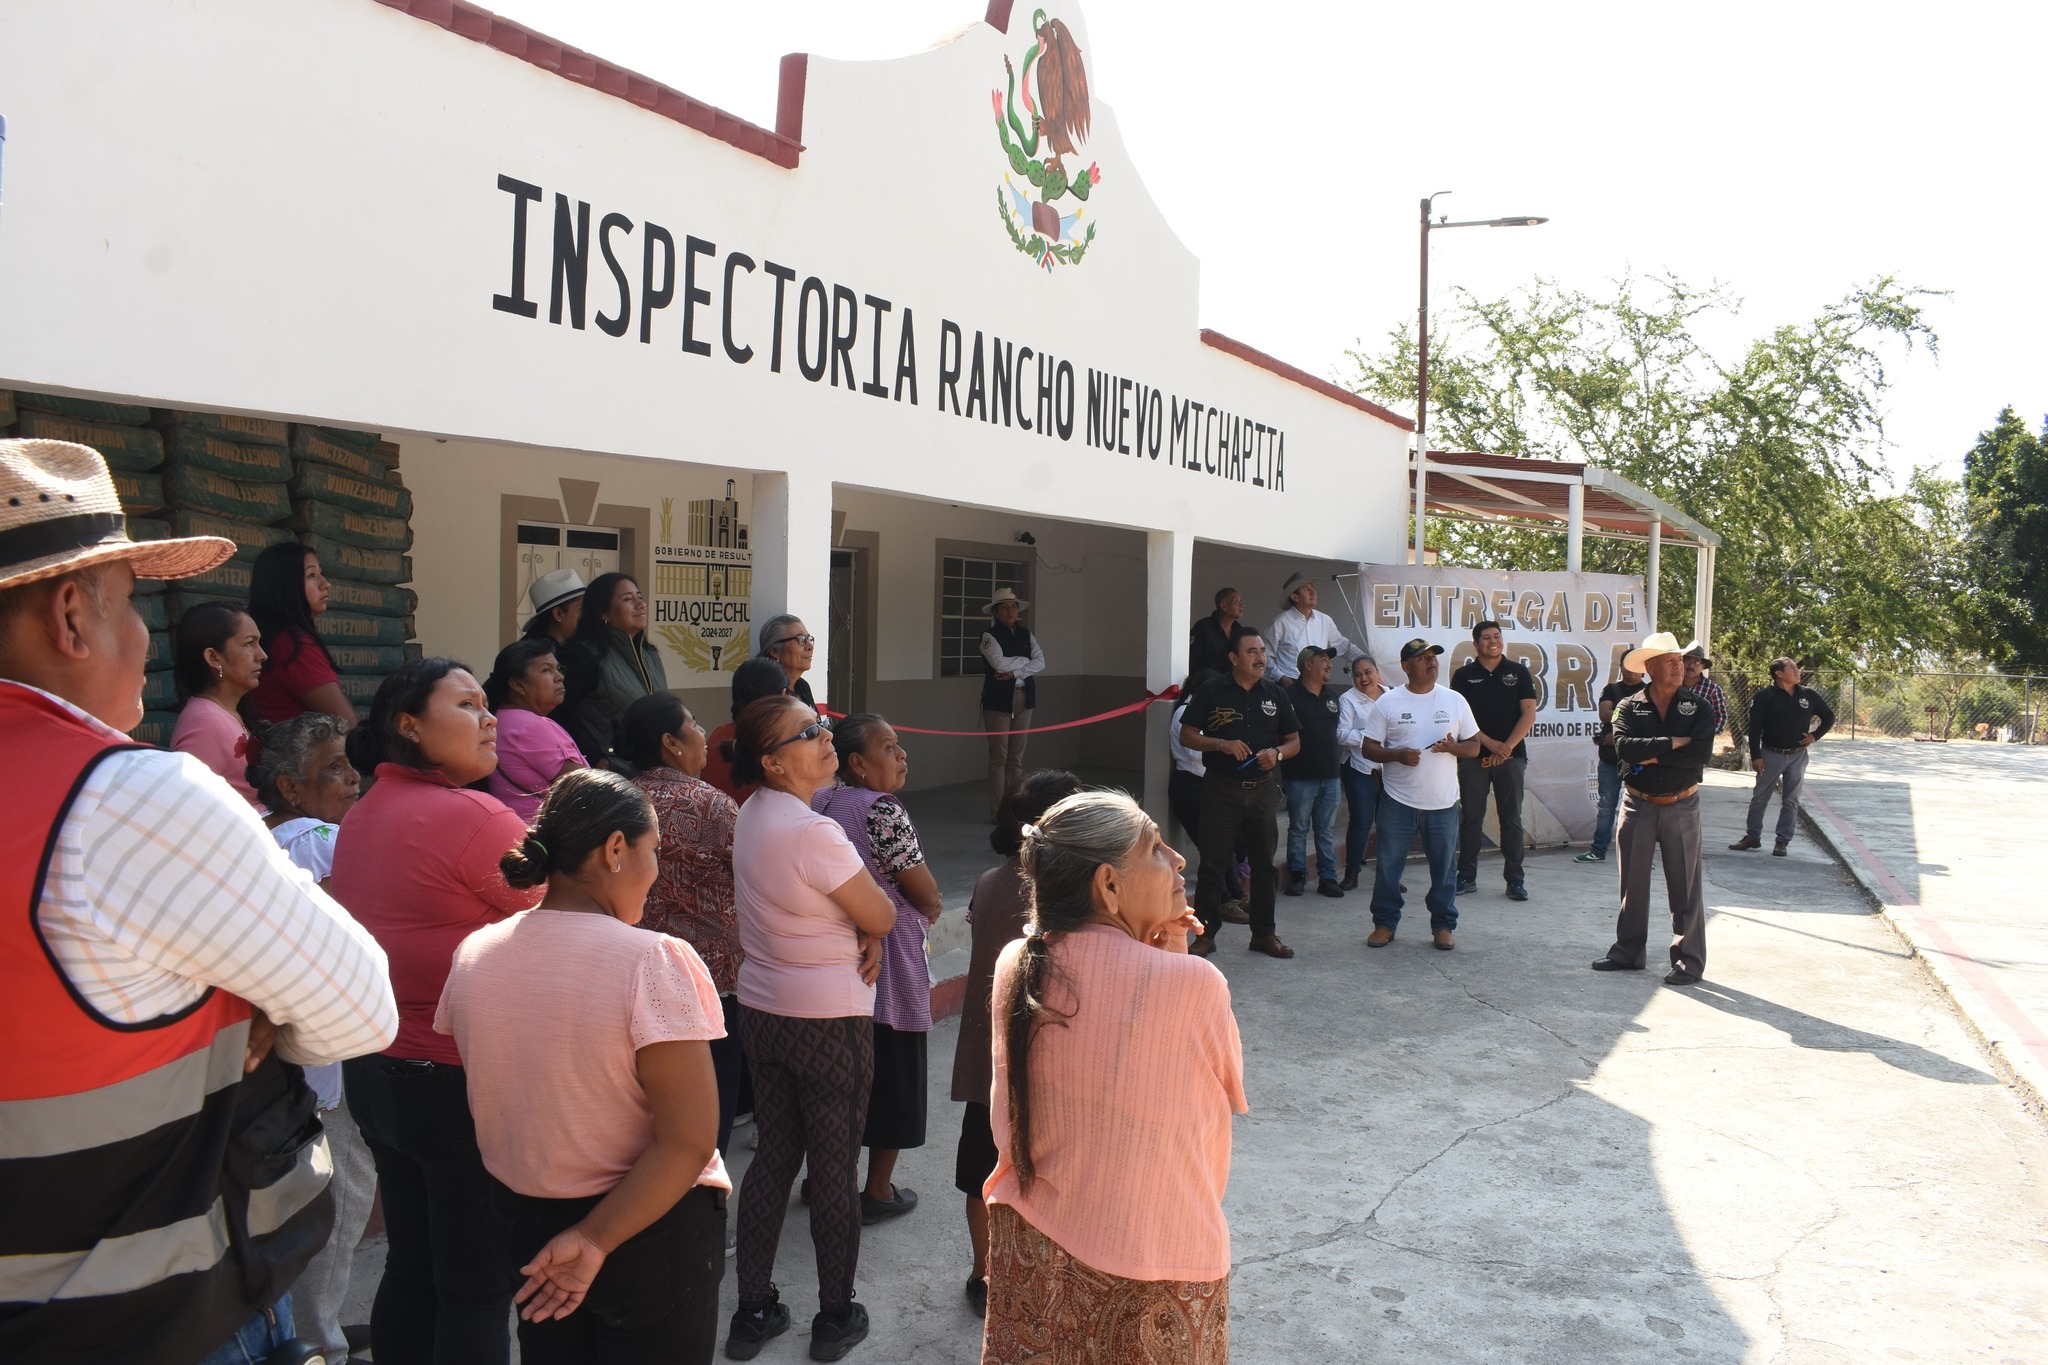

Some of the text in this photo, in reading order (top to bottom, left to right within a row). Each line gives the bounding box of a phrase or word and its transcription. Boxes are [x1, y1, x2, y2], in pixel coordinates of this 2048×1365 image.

[493, 173, 1285, 492] INSPECTORIA RANCHO NUEVO MICHAPITA
[204, 437, 281, 468] MOCTEZUMA
[307, 436, 373, 475] MOCTEZUMA
[326, 474, 399, 508] MOCTEZUMA
[655, 546, 752, 561] GOBIERNO DE RESULT
[194, 567, 252, 588] OCTEZU
[328, 585, 384, 608] OCTEZUMA
[1373, 584, 1637, 632] ENTREGA DE
[655, 600, 751, 626] HUAQUECHU
[329, 649, 380, 667] CTEZUMA
[1524, 722, 1564, 738] IERNO
[1567, 722, 1582, 737] DE
